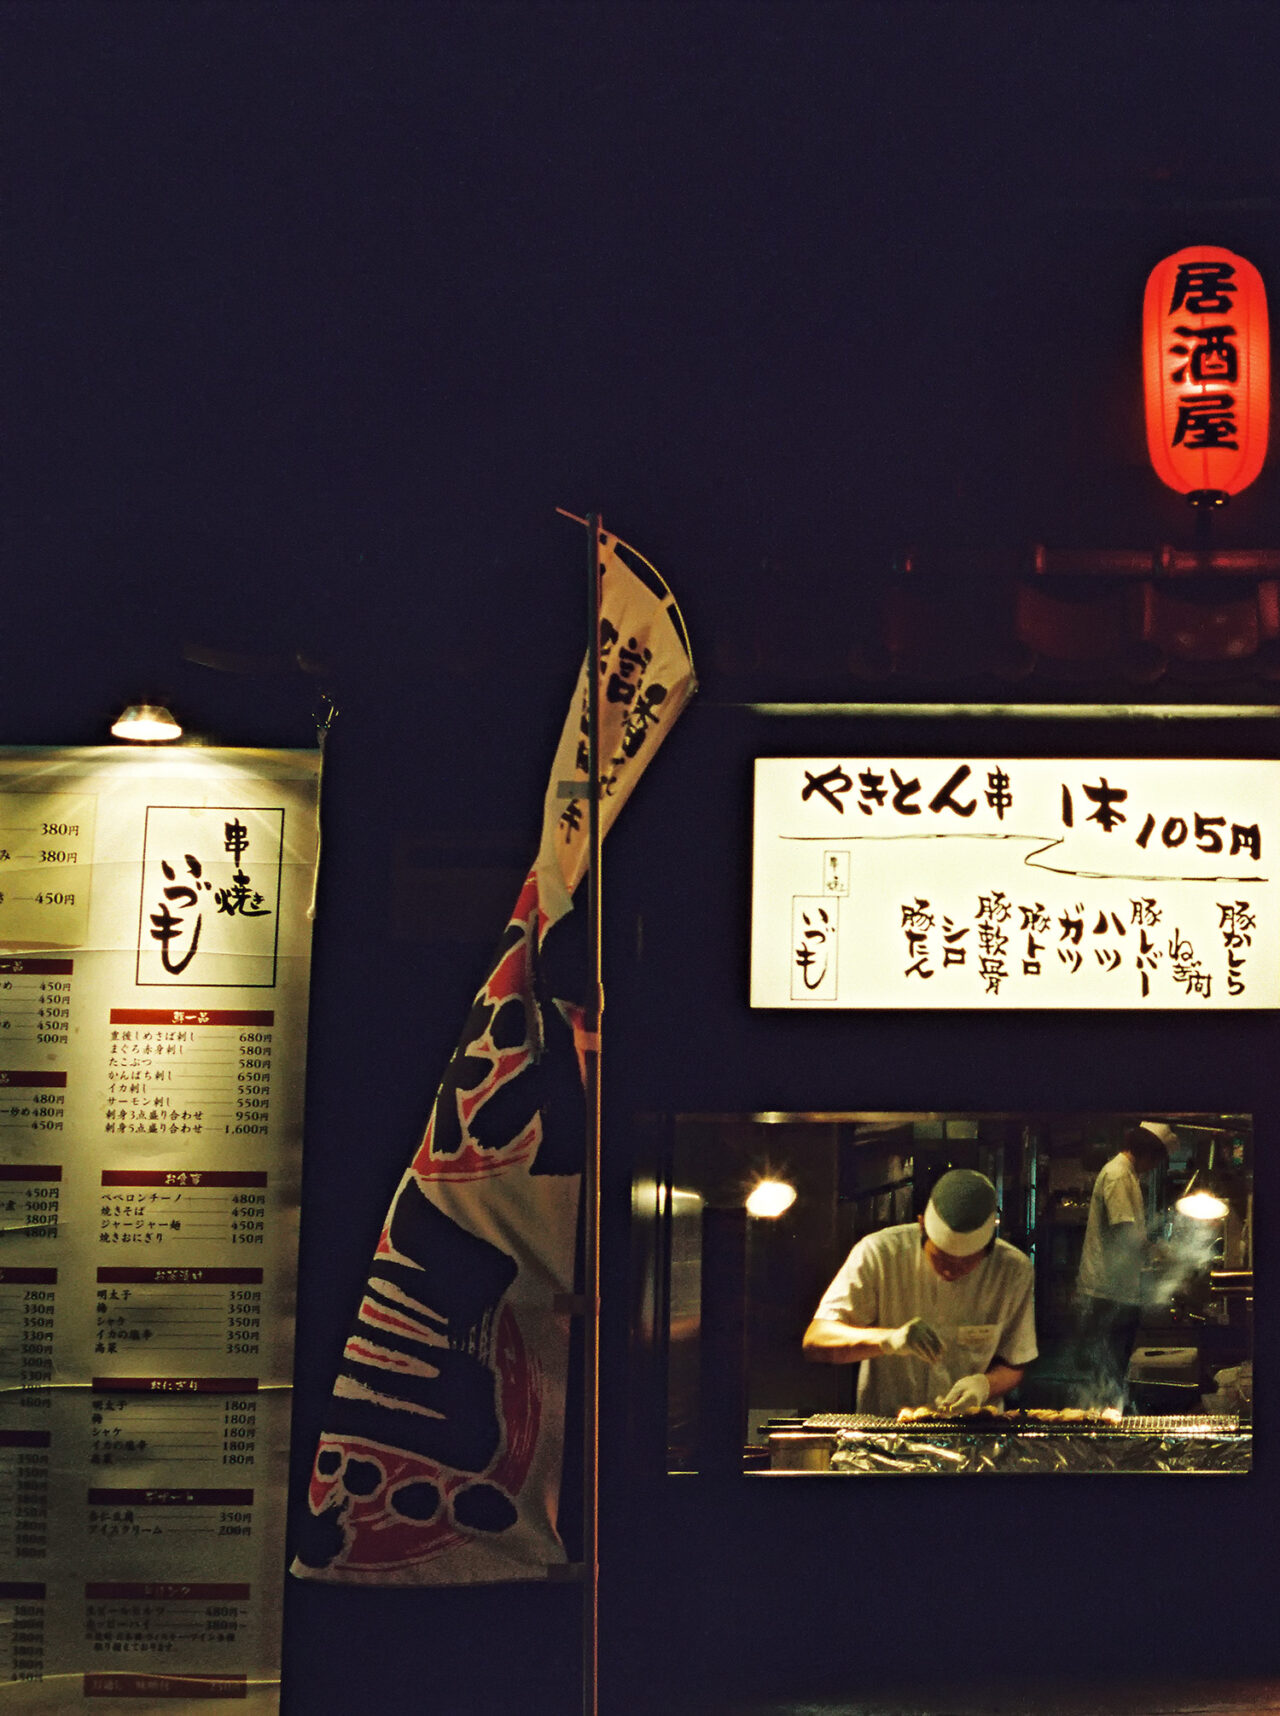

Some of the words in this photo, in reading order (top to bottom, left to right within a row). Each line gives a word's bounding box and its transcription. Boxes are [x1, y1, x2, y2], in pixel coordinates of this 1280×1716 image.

[1168, 261, 1239, 451] 居酒屋
[801, 764, 1013, 821] やきとん串
[39, 823, 80, 837] 380円
[38, 850, 78, 864] 380円
[214, 817, 272, 917] 串焼き
[35, 892, 75, 905] 450円
[150, 854, 211, 975] いづも
[901, 896, 935, 979] 豚たん
[942, 915, 970, 969] シロ
[975, 890, 1012, 996] 豚軟骨
[1018, 902, 1051, 976] 豚トロ
[1057, 902, 1085, 974] ガツ
[1093, 910, 1126, 972] ハツ
[795, 908, 836, 990] いづも
[1129, 897, 1164, 998] 豚レバー
[1216, 901, 1257, 996] 豚かしら
[39, 982, 71, 992] 450円
[38, 995, 70, 1005] 450円
[37, 1008, 70, 1018] 450円
[36, 1021, 69, 1031] 450円
[36, 1034, 68, 1044] 500円
[109, 1083, 147, 1094] イカ刺し
[33, 1095, 65, 1105] 480円
[107, 1096, 171, 1107] サーモン刺し
[32, 1107, 64, 1117] 480円
[31, 1120, 63, 1131] 450円
[26, 1188, 59, 1198] 450円
[26, 1201, 59, 1212] 500円
